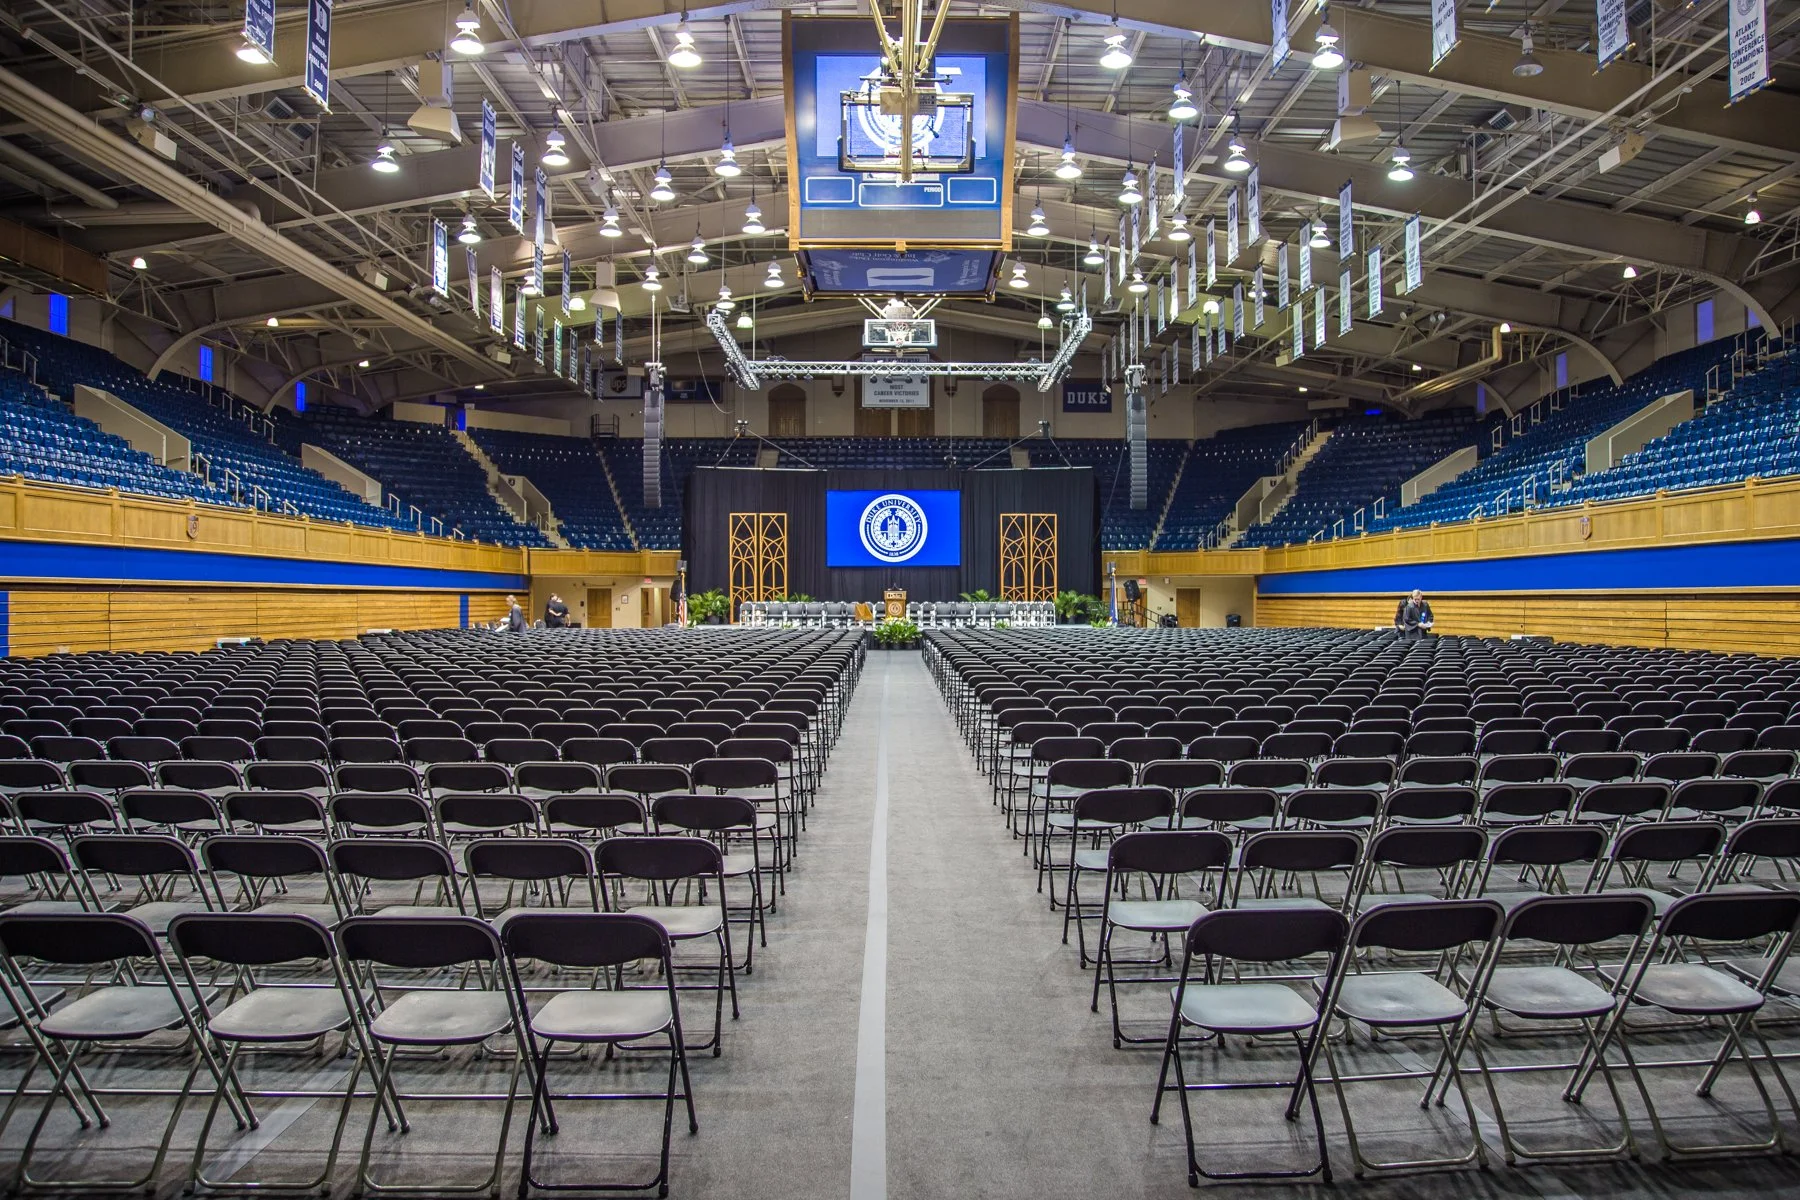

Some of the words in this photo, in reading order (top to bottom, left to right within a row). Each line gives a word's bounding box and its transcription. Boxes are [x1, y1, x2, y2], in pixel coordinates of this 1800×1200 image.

[1734, 17, 1759, 38] ATLANTIC
[1738, 29, 1756, 45] COAST
[1731, 33, 1765, 60] CONFERENCE
[1732, 44, 1764, 69] CHAMPIONS
[1740, 72, 1756, 85] 2002
[1067, 391, 1108, 405] DUKE
[866, 504, 881, 524] DUKE
[881, 499, 922, 524] UNIVERSITY
